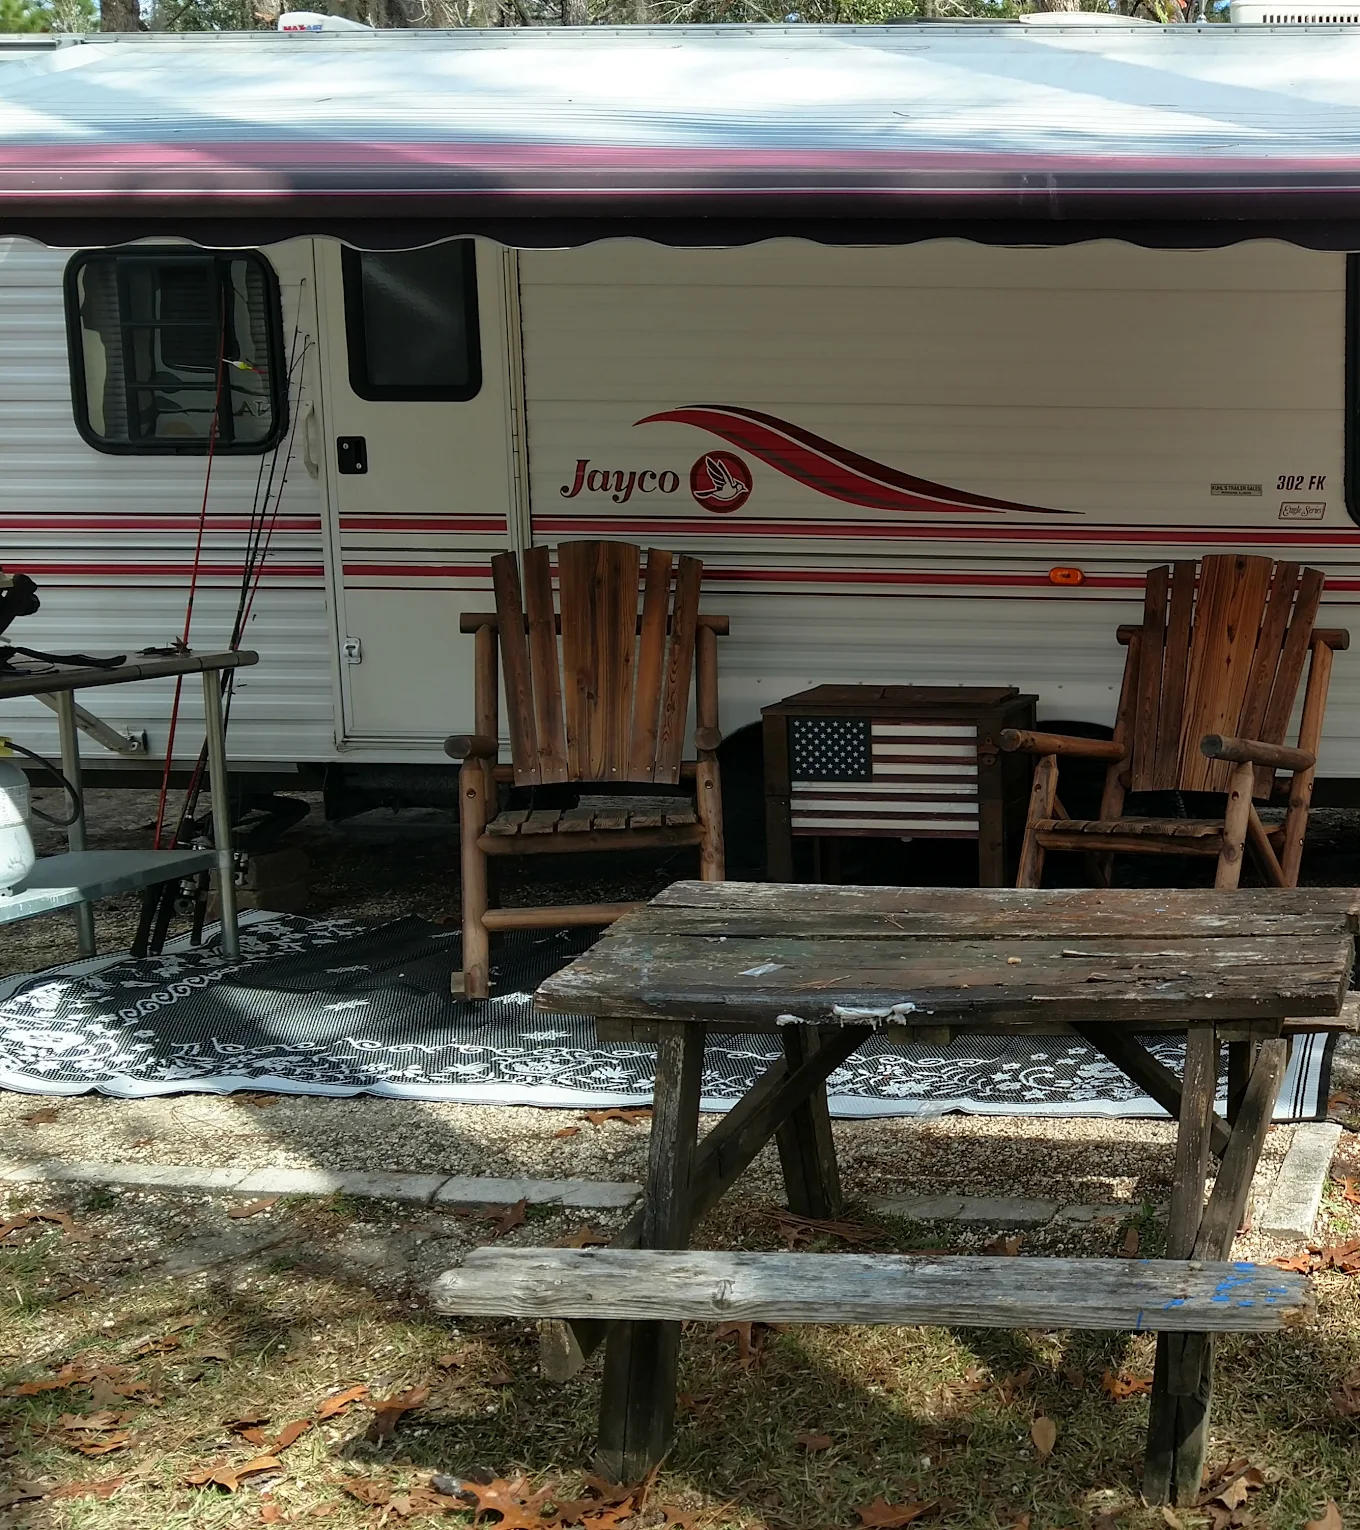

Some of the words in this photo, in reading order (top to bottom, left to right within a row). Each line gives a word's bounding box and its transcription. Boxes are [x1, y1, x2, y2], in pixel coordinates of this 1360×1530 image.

[560, 458, 680, 504] Jayco
[1276, 475, 1305, 491] 302
[1308, 475, 1327, 491] FK
